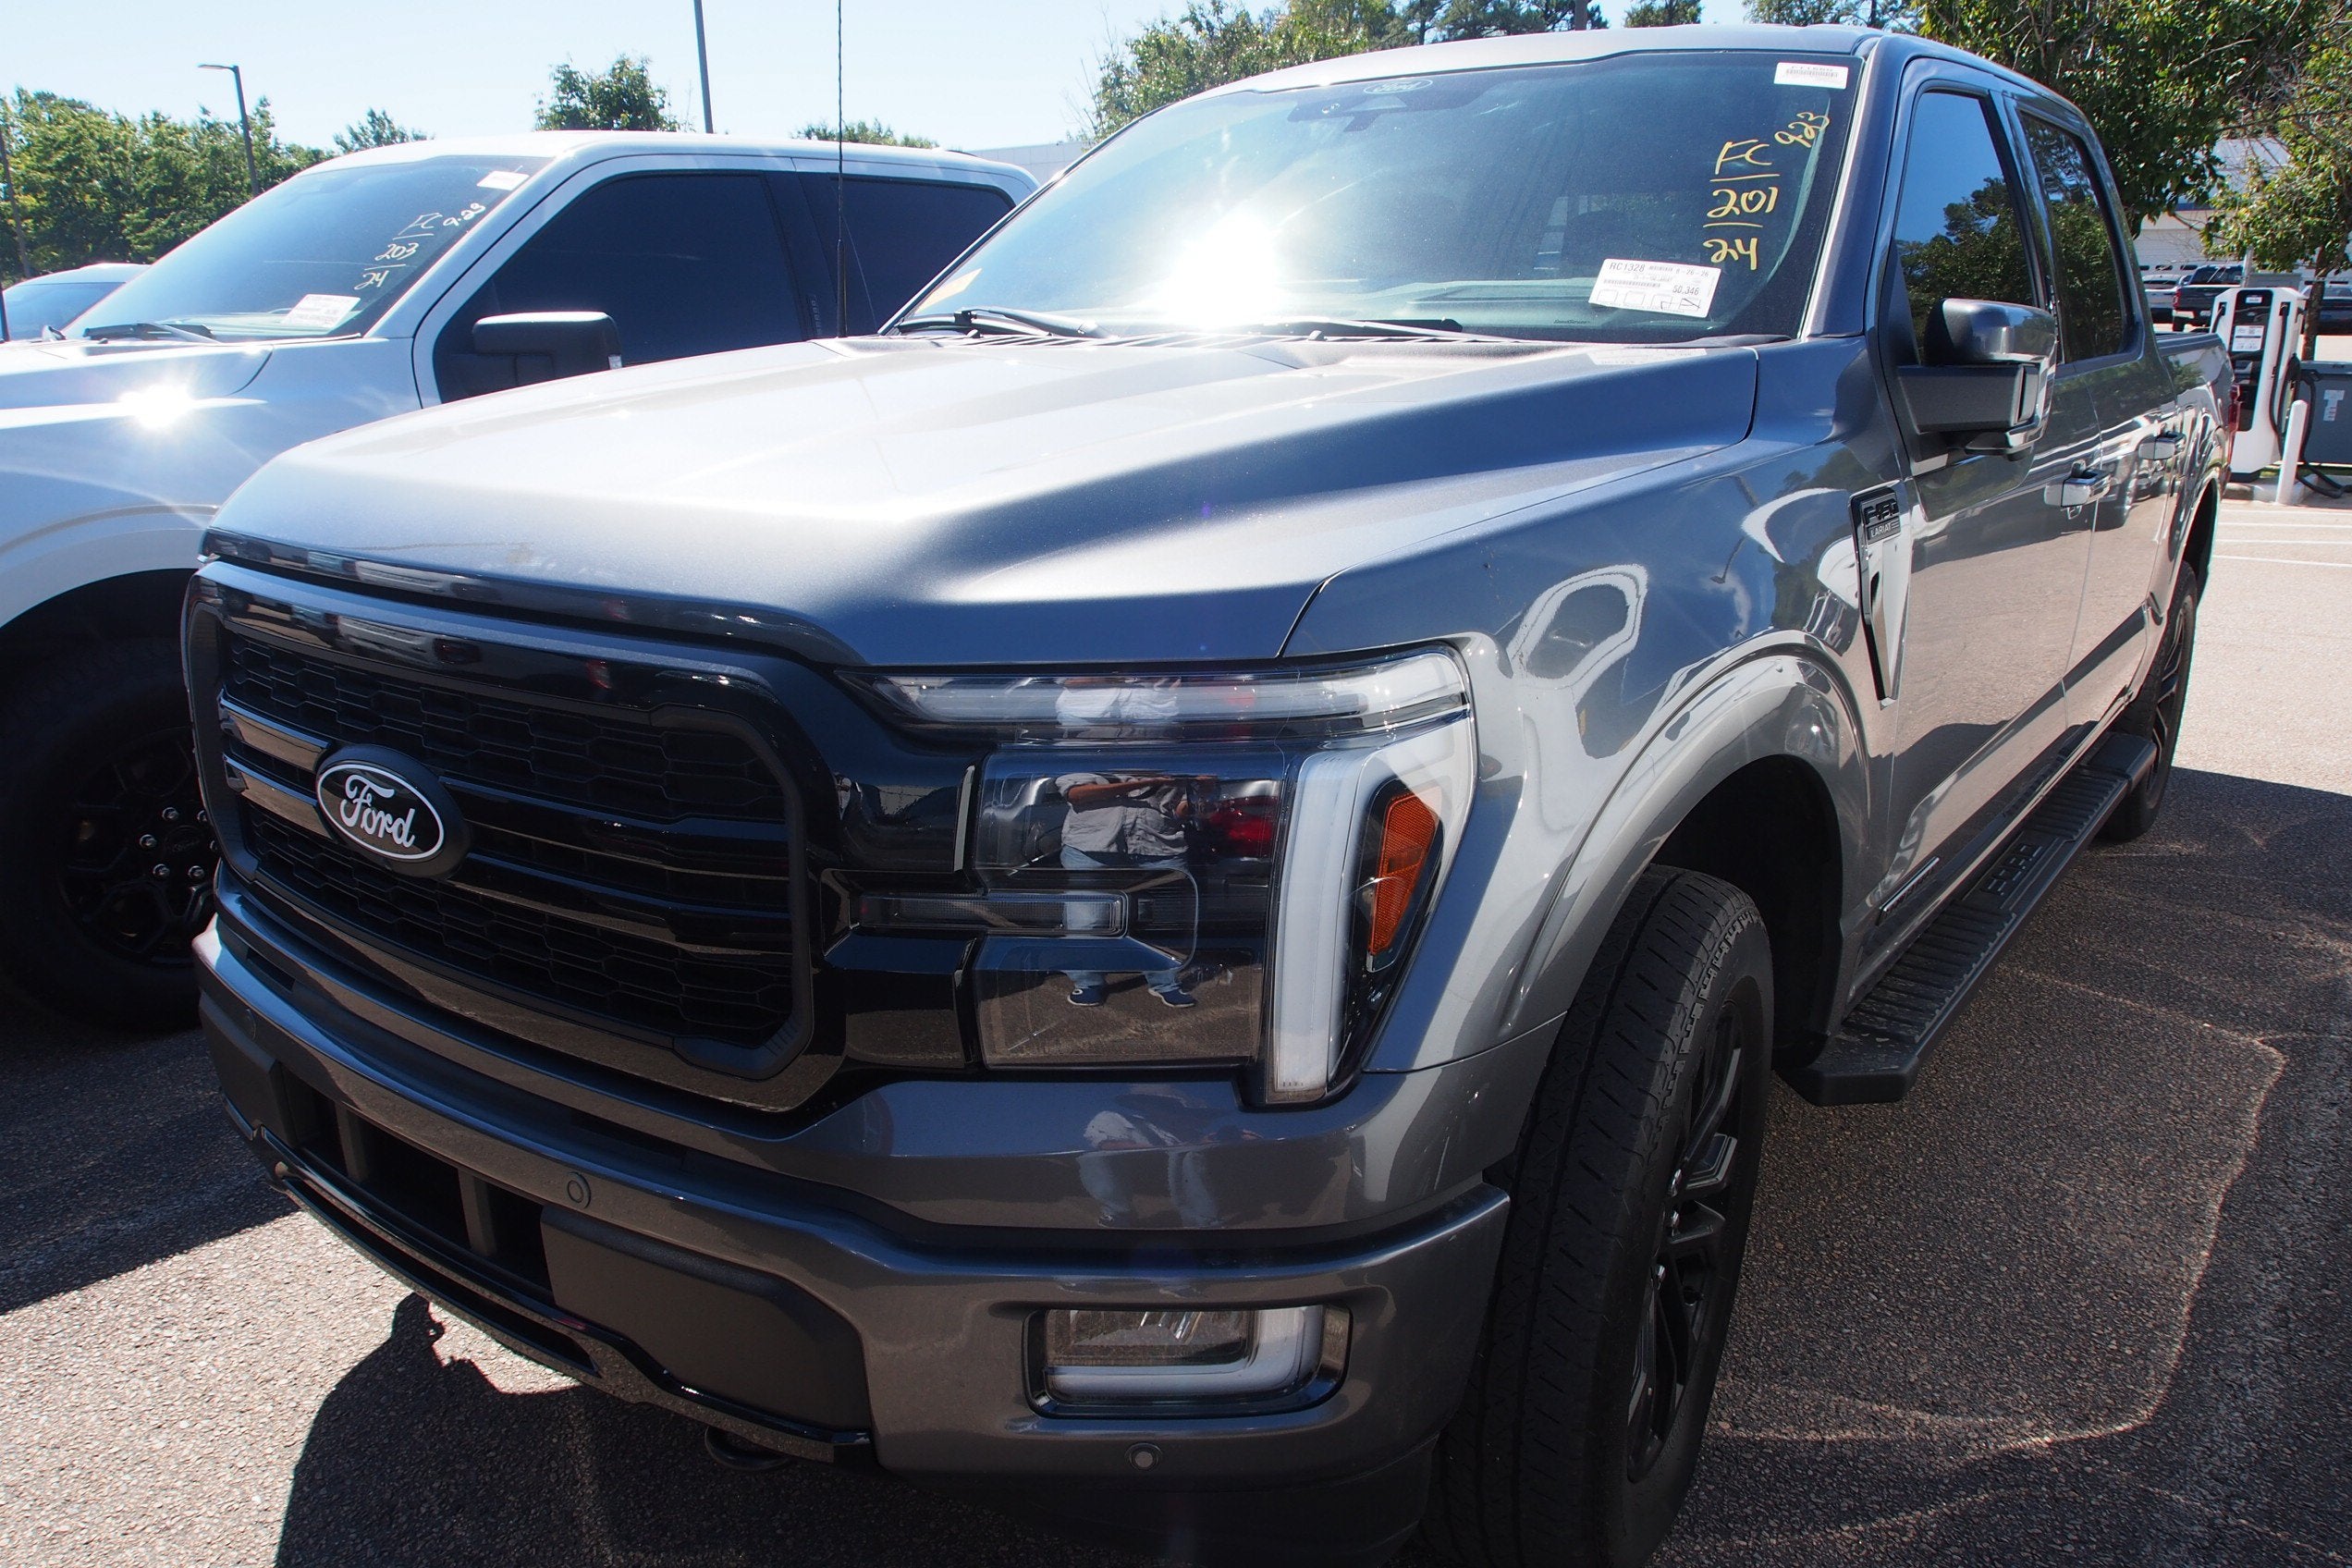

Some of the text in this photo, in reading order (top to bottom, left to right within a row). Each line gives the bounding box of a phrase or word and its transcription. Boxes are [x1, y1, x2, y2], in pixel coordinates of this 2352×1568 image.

[1707, 186, 1779, 218] 201
[374, 242, 419, 262] 203
[1702, 237, 1758, 270] 24
[1609, 262, 1646, 273] RC1328
[353, 270, 390, 290] 24
[1870, 522, 1892, 538] LARIAT
[339, 774, 416, 848] Ford
